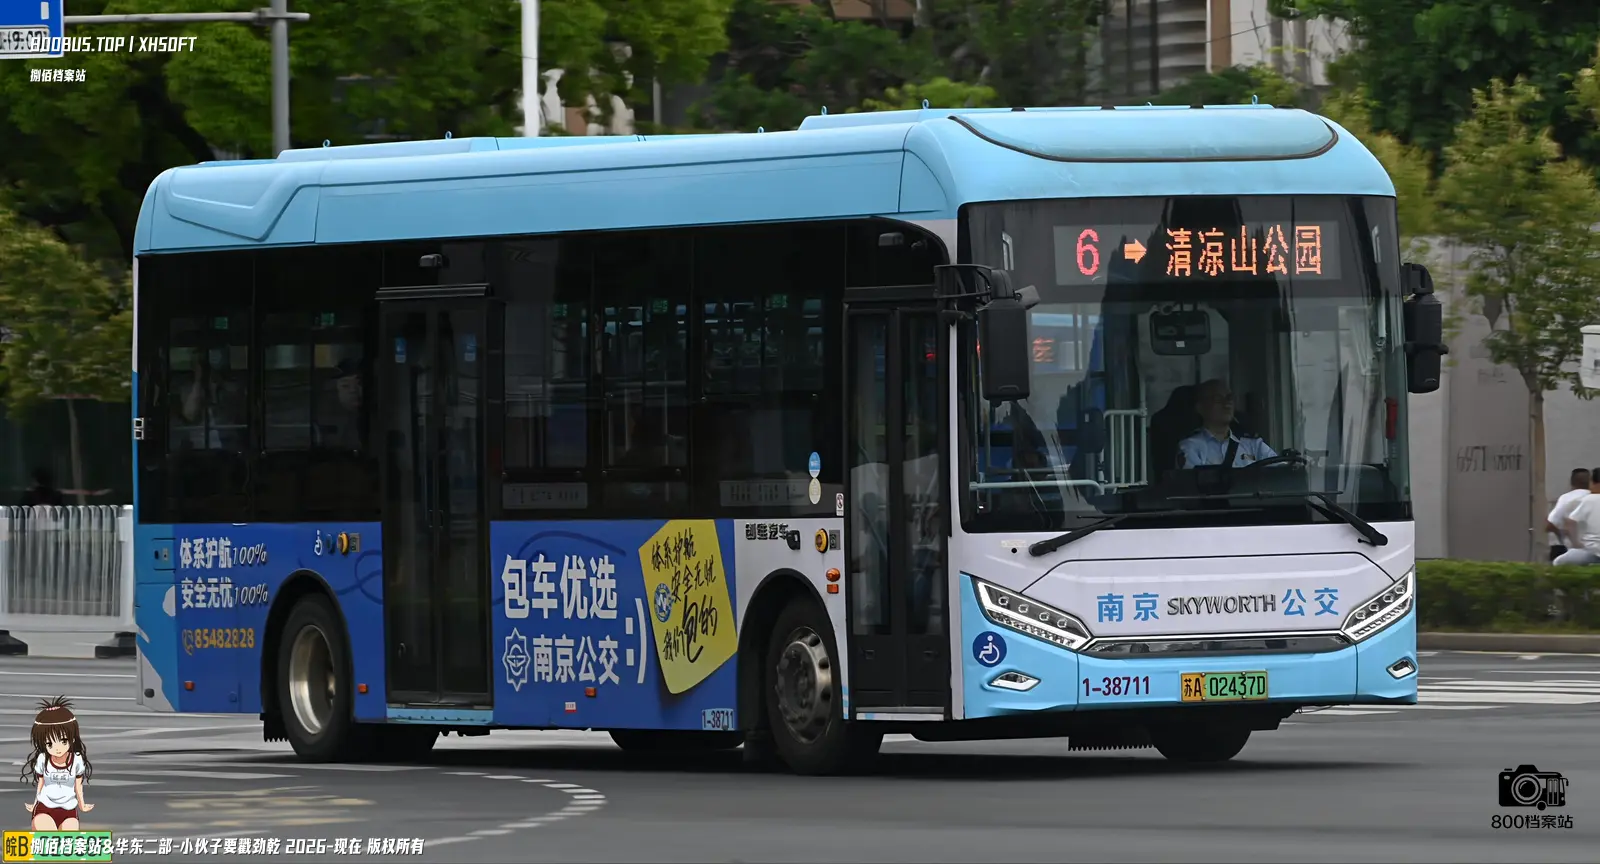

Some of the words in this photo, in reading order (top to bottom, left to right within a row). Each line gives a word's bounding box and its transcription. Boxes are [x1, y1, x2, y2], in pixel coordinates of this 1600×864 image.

[1076, 228, 1099, 276] 6
[1165, 224, 1321, 277] 清凉山公园
[501, 553, 618, 620] 包车优选
[1096, 592, 1160, 622] 南京
[1167, 594, 1277, 616] SKYWORTH
[1281, 587, 1339, 616] 公交
[194, 628, 255, 649] 85482828
[533, 634, 620, 685] 南京公交
[1082, 675, 1150, 696] 1-38711
[702, 710, 734, 729] 1-38711
